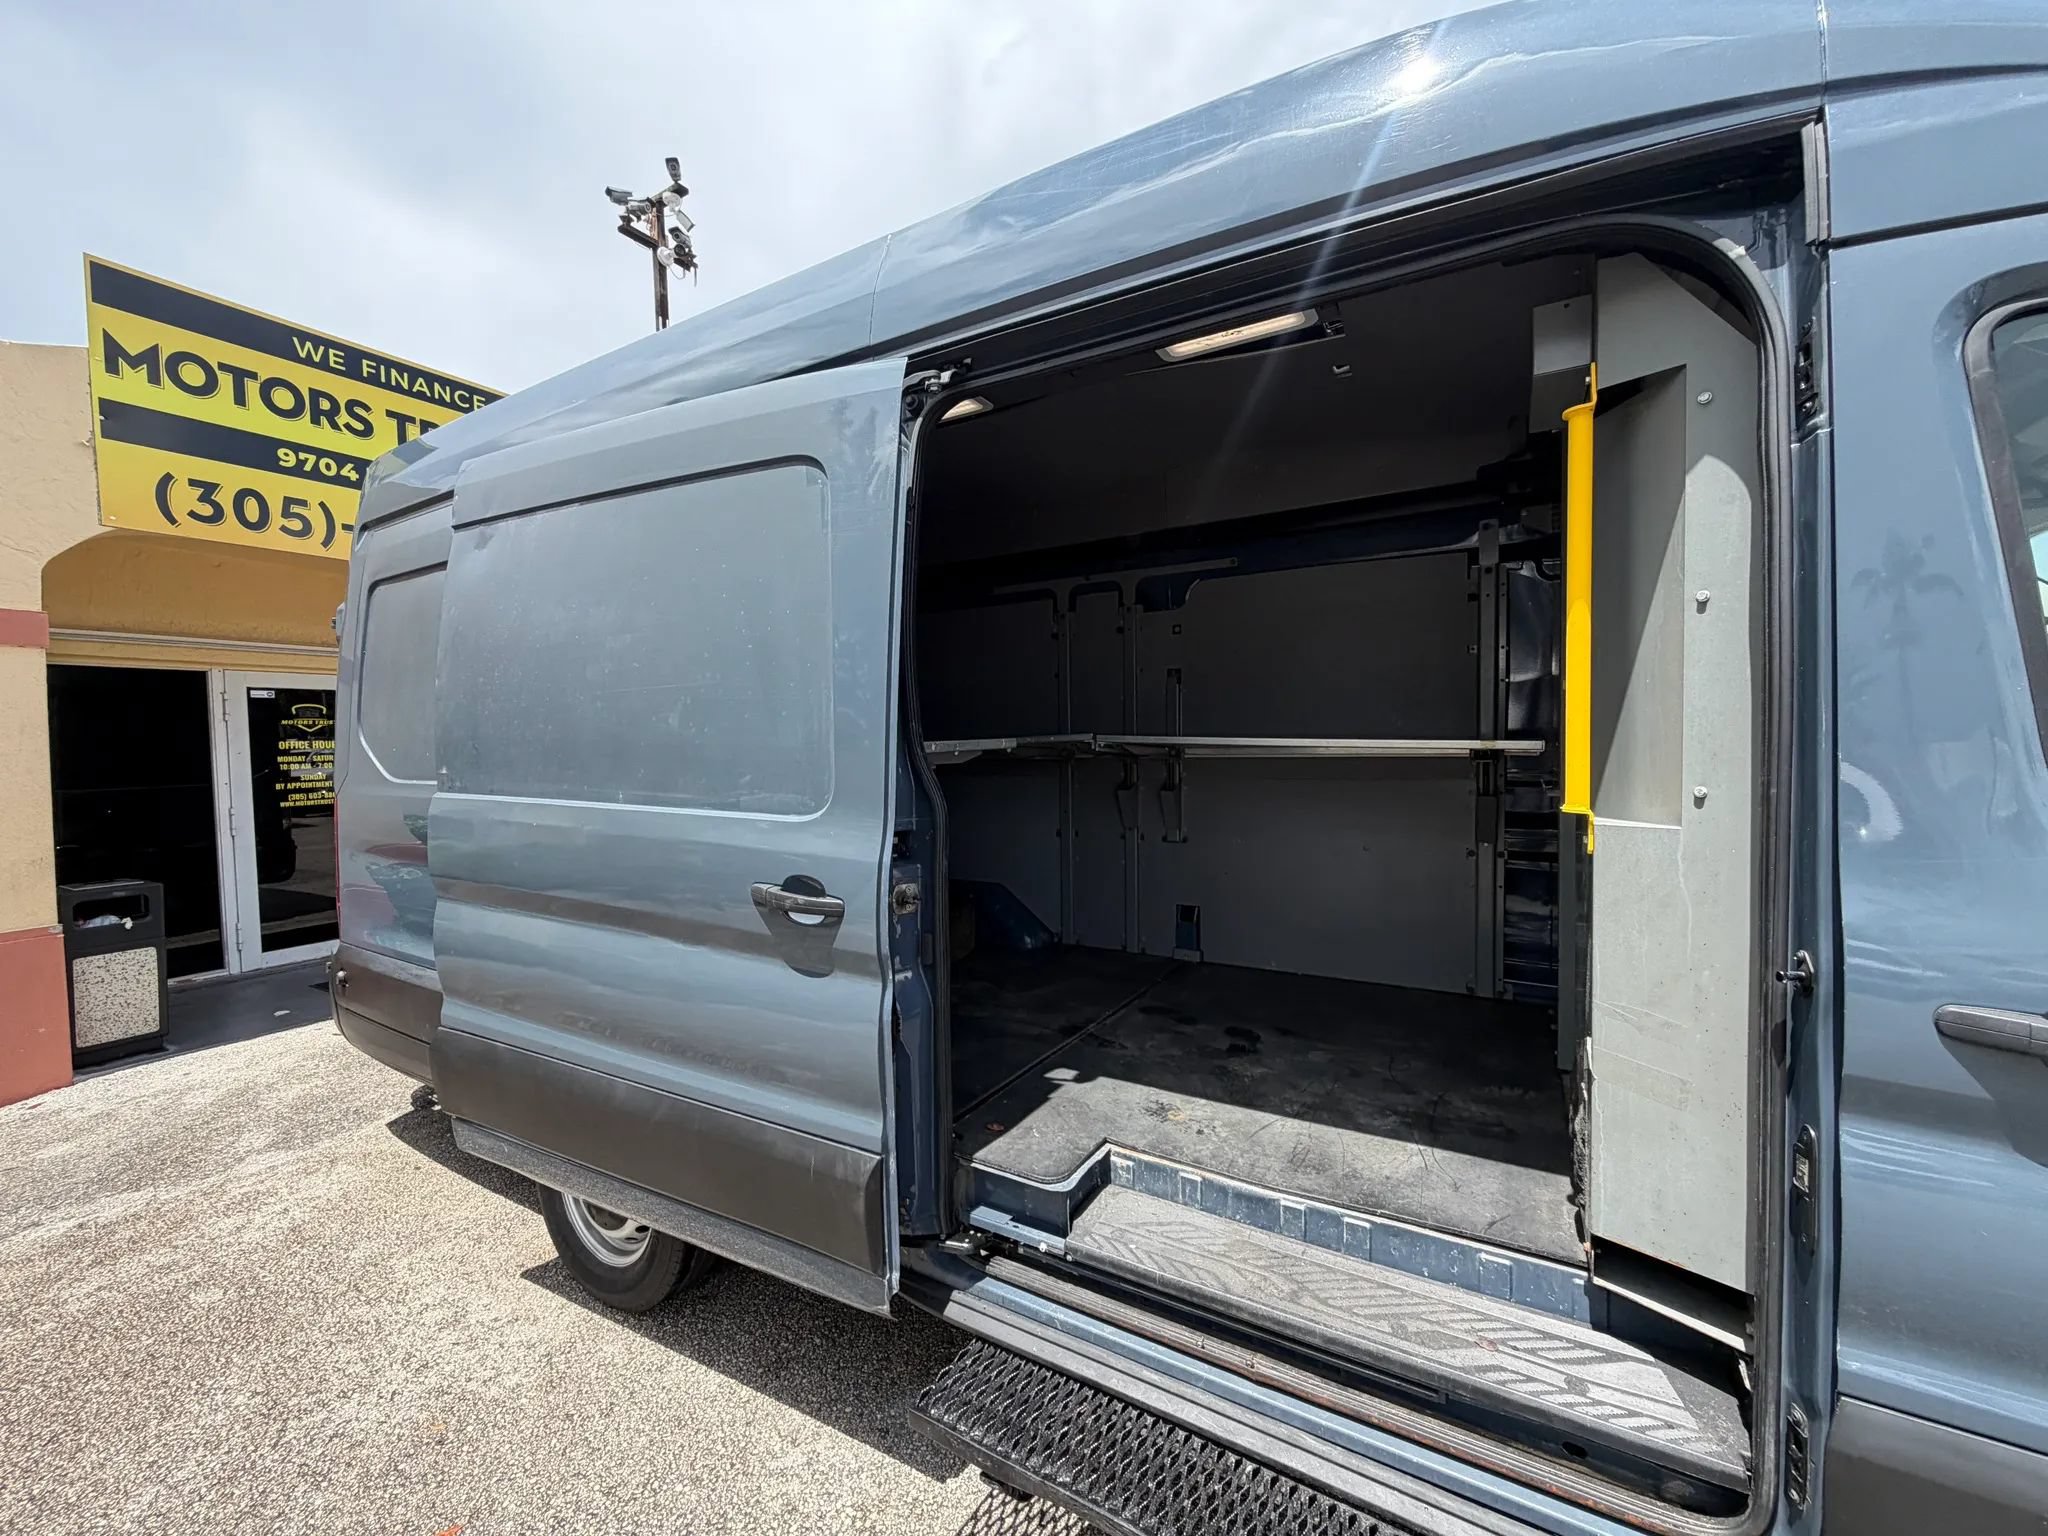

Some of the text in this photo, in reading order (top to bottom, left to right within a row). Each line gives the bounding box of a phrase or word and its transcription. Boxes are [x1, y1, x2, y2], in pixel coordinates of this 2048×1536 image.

[102, 327, 376, 440] MOTORS
[293, 336, 486, 411] WE FINANCE
[276, 448, 360, 481] 9704
[279, 740, 310, 749] OFFICE
[287, 781, 333, 789] APPOINTMENT
[288, 793, 307, 801] (305)
